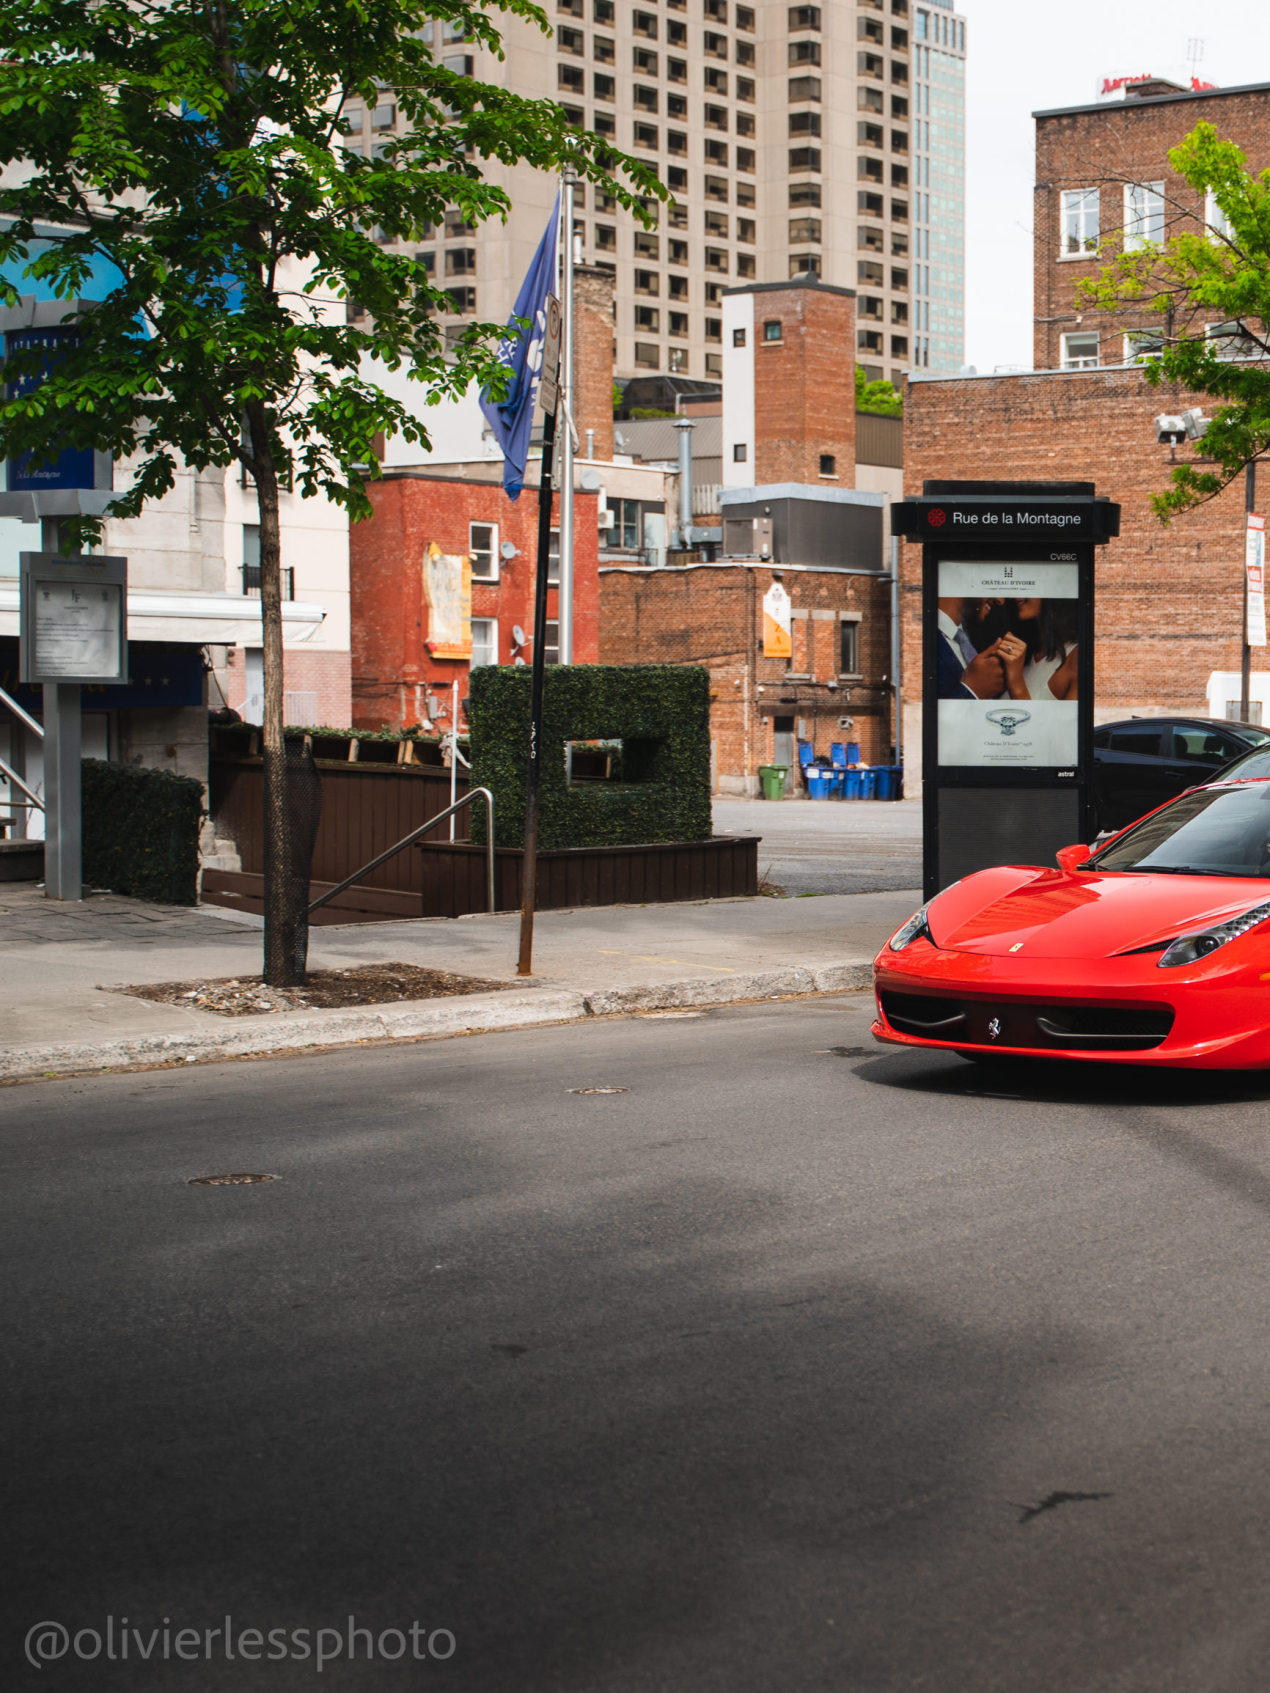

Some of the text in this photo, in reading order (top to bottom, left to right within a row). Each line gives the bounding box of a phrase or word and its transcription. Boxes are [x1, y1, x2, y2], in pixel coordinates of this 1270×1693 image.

[953, 512, 1081, 528] Rue de la Montagne
[1050, 553, 1077, 561] CV66C
